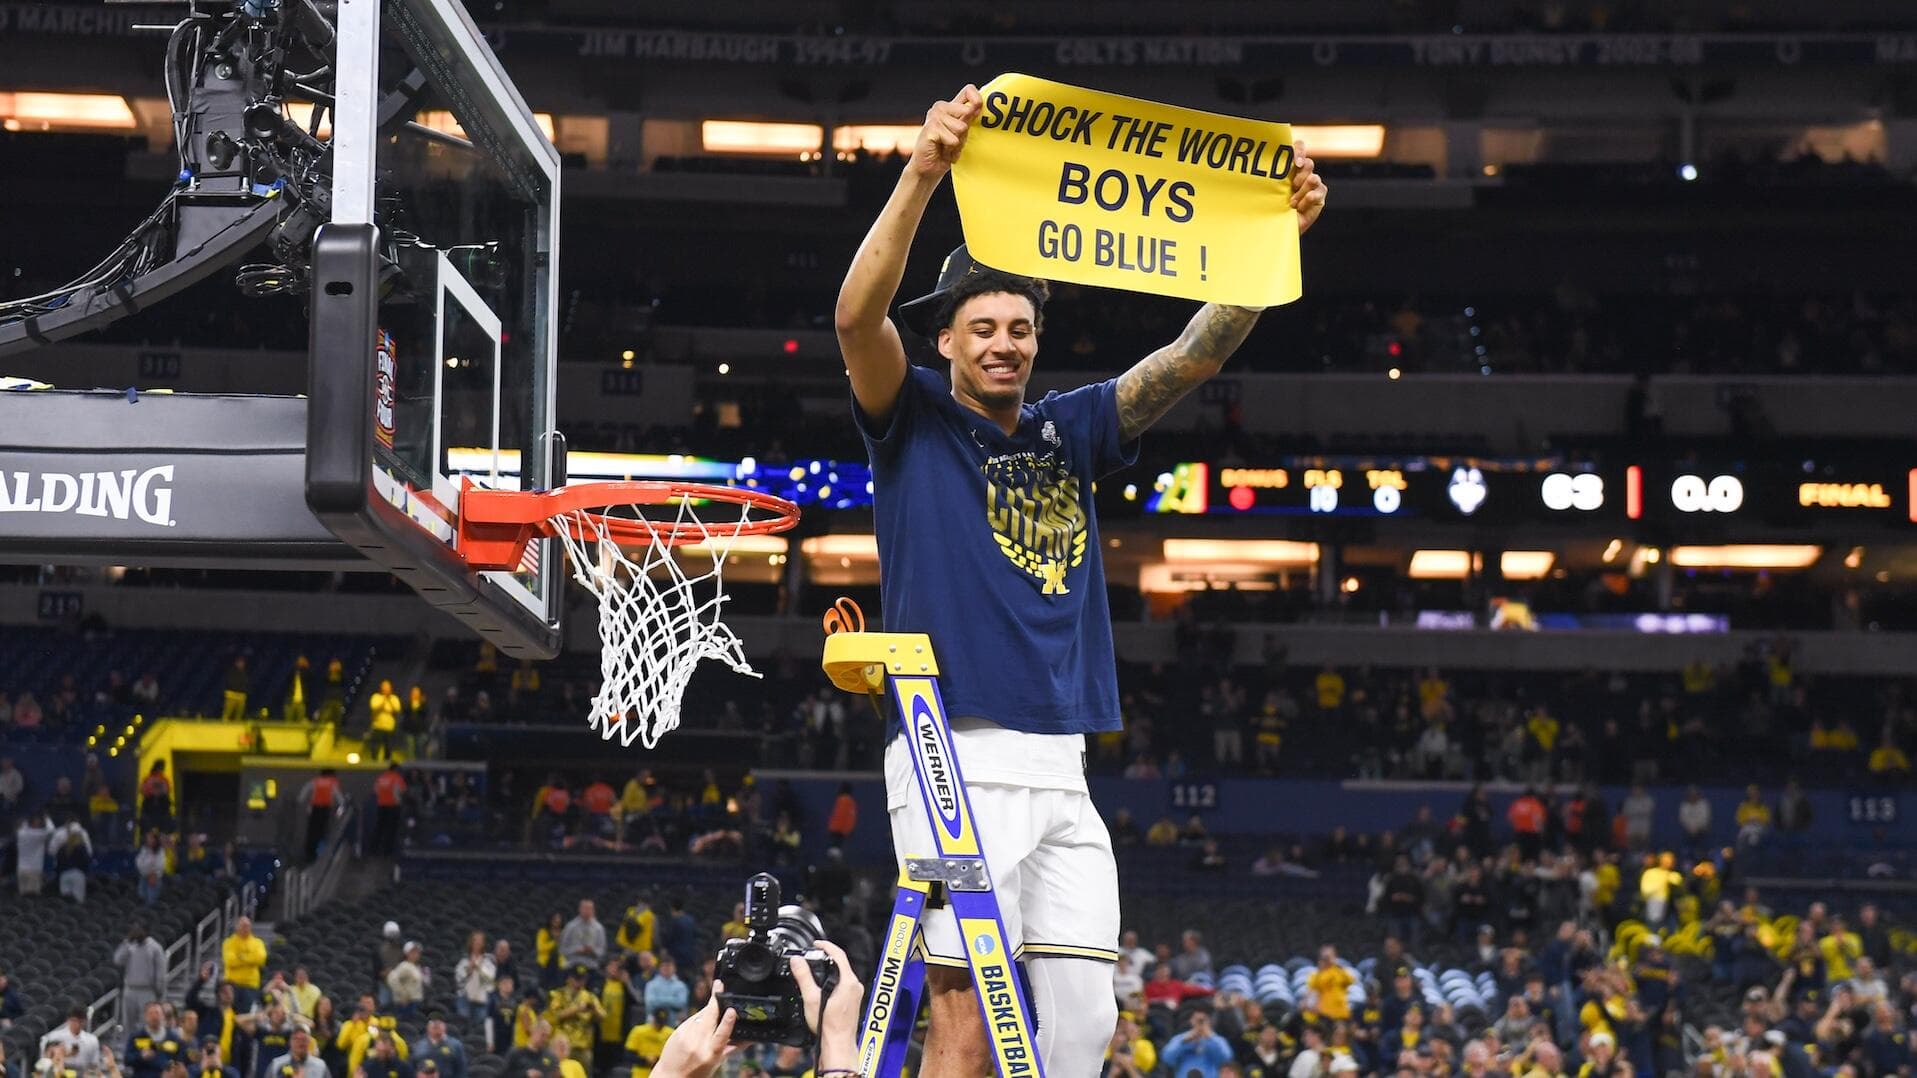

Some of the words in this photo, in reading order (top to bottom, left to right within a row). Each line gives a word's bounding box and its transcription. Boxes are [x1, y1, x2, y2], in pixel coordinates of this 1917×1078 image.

[578, 33, 626, 56] JIM
[634, 35, 779, 62] HARBAUGH
[1056, 39, 1137, 65] COLTS
[1144, 39, 1242, 64] NATION
[981, 91, 1103, 146] SHOCK
[1107, 114, 1173, 158] THE
[1177, 127, 1295, 181] WORLD
[1058, 161, 1196, 223] BOYS
[1038, 219, 1082, 263] GO
[1095, 229, 1177, 278] BLUE
[1200, 245, 1208, 282] !
[1543, 474, 1603, 509] 63
[1671, 475, 1743, 512] 0.0
[1800, 483, 1889, 507] FINAL
[920, 723, 954, 810] WERNER
[1173, 784, 1216, 807] 112
[894, 921, 908, 955] PODIO
[869, 957, 901, 1034] PODIUM
